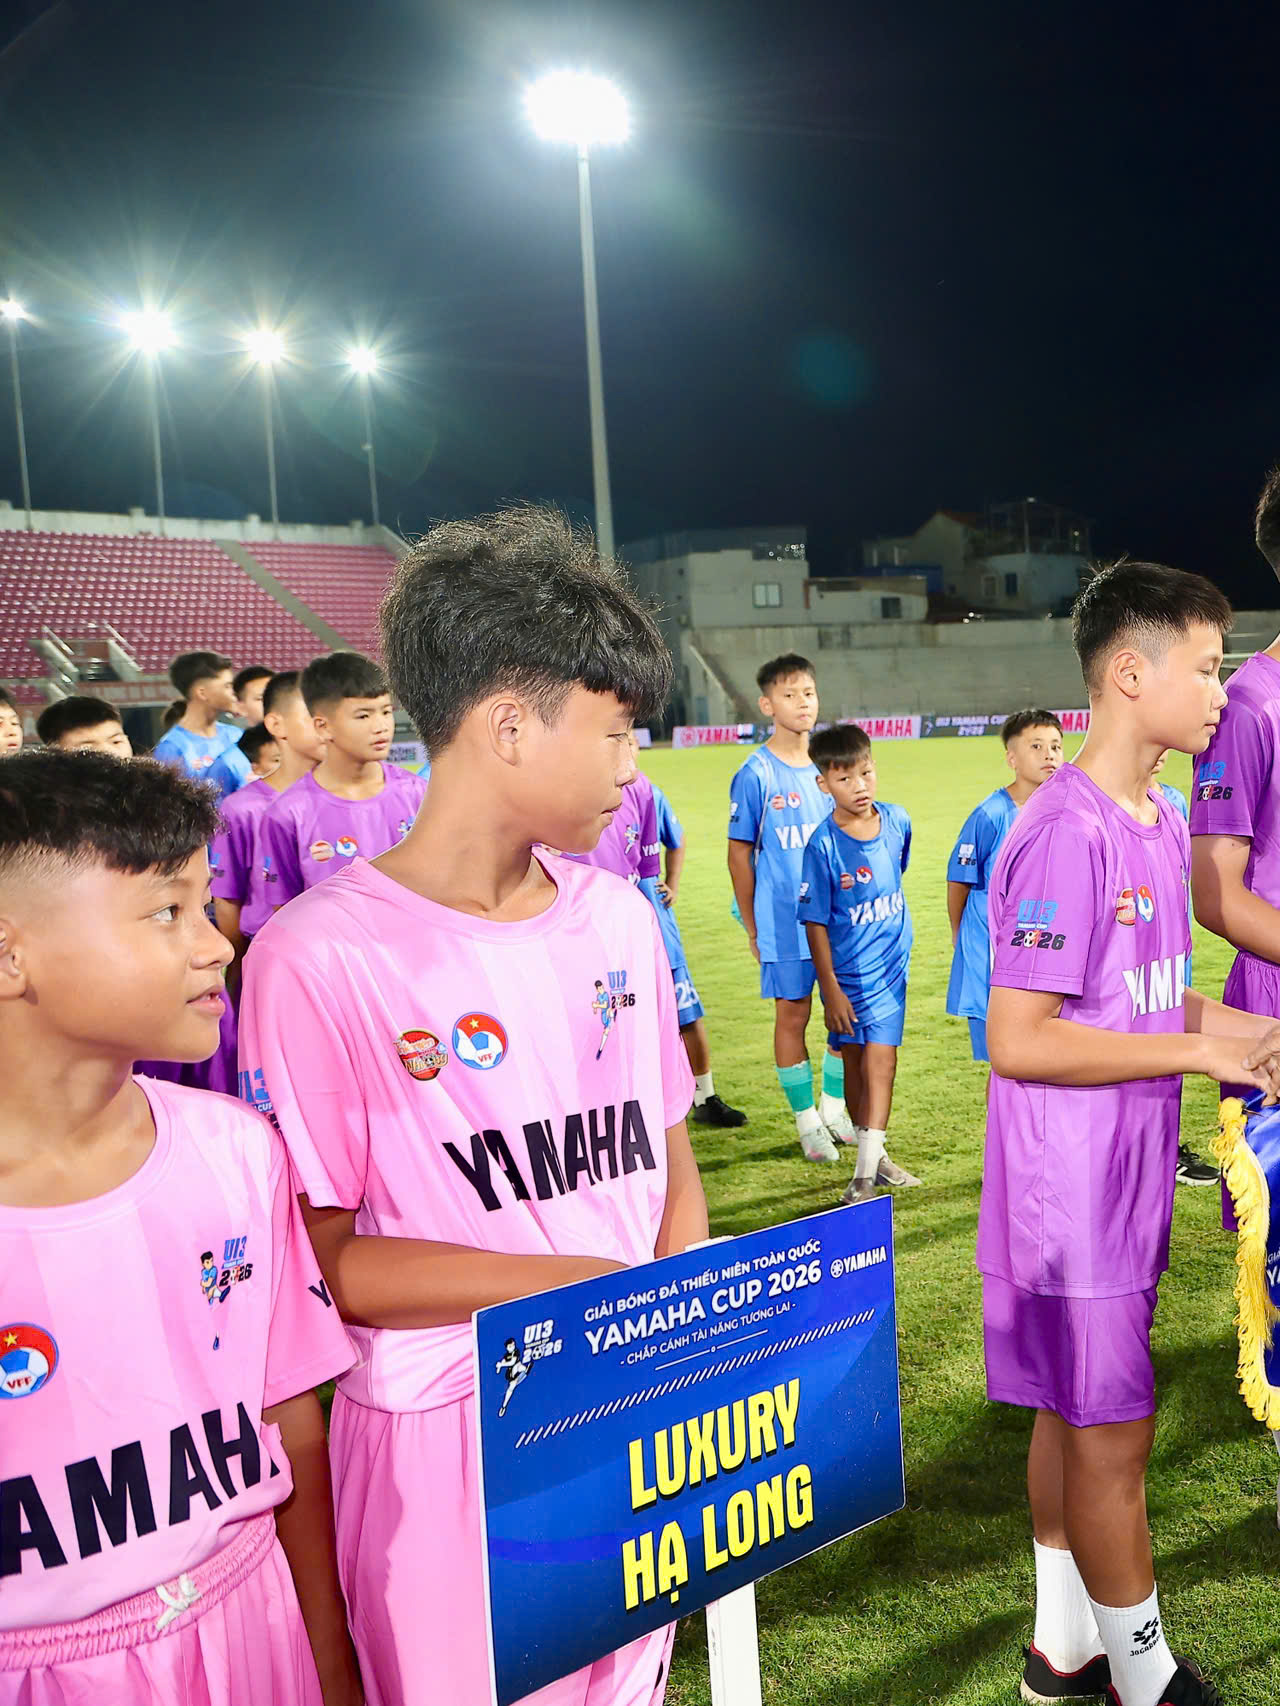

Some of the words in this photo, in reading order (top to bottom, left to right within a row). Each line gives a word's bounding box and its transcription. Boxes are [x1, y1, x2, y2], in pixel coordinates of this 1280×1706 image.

[1018, 900, 1058, 923] U13
[607, 970, 627, 989] U13
[224, 1235, 247, 1260] U13
[844, 1245, 887, 1274] YAMAHA
[584, 1299, 614, 1322] GIẢI
[617, 1290, 657, 1313] BÓNG
[659, 1280, 680, 1300] ĐÁ
[681, 1268, 719, 1293] THIẾU
[721, 1259, 750, 1280] NIÊN
[752, 1250, 786, 1271] TOÀN
[787, 1238, 821, 1262] QUỐC
[584, 1297, 706, 1355] YAMAHA
[711, 1279, 763, 1314] CUP
[767, 1260, 822, 1298] 2026
[523, 1319, 554, 1344] U13
[659, 1335, 690, 1352] CÁNH
[691, 1327, 708, 1343] TÀI
[709, 1318, 739, 1337] NĂNG
[740, 1306, 774, 1327] TƯƠNG
[776, 1301, 791, 1316] LAI
[7, 1376, 32, 1389] VFF
[628, 1377, 800, 1511] LUXURY
[622, 1520, 689, 1611] HẠ
[702, 1463, 814, 1573] LONG
